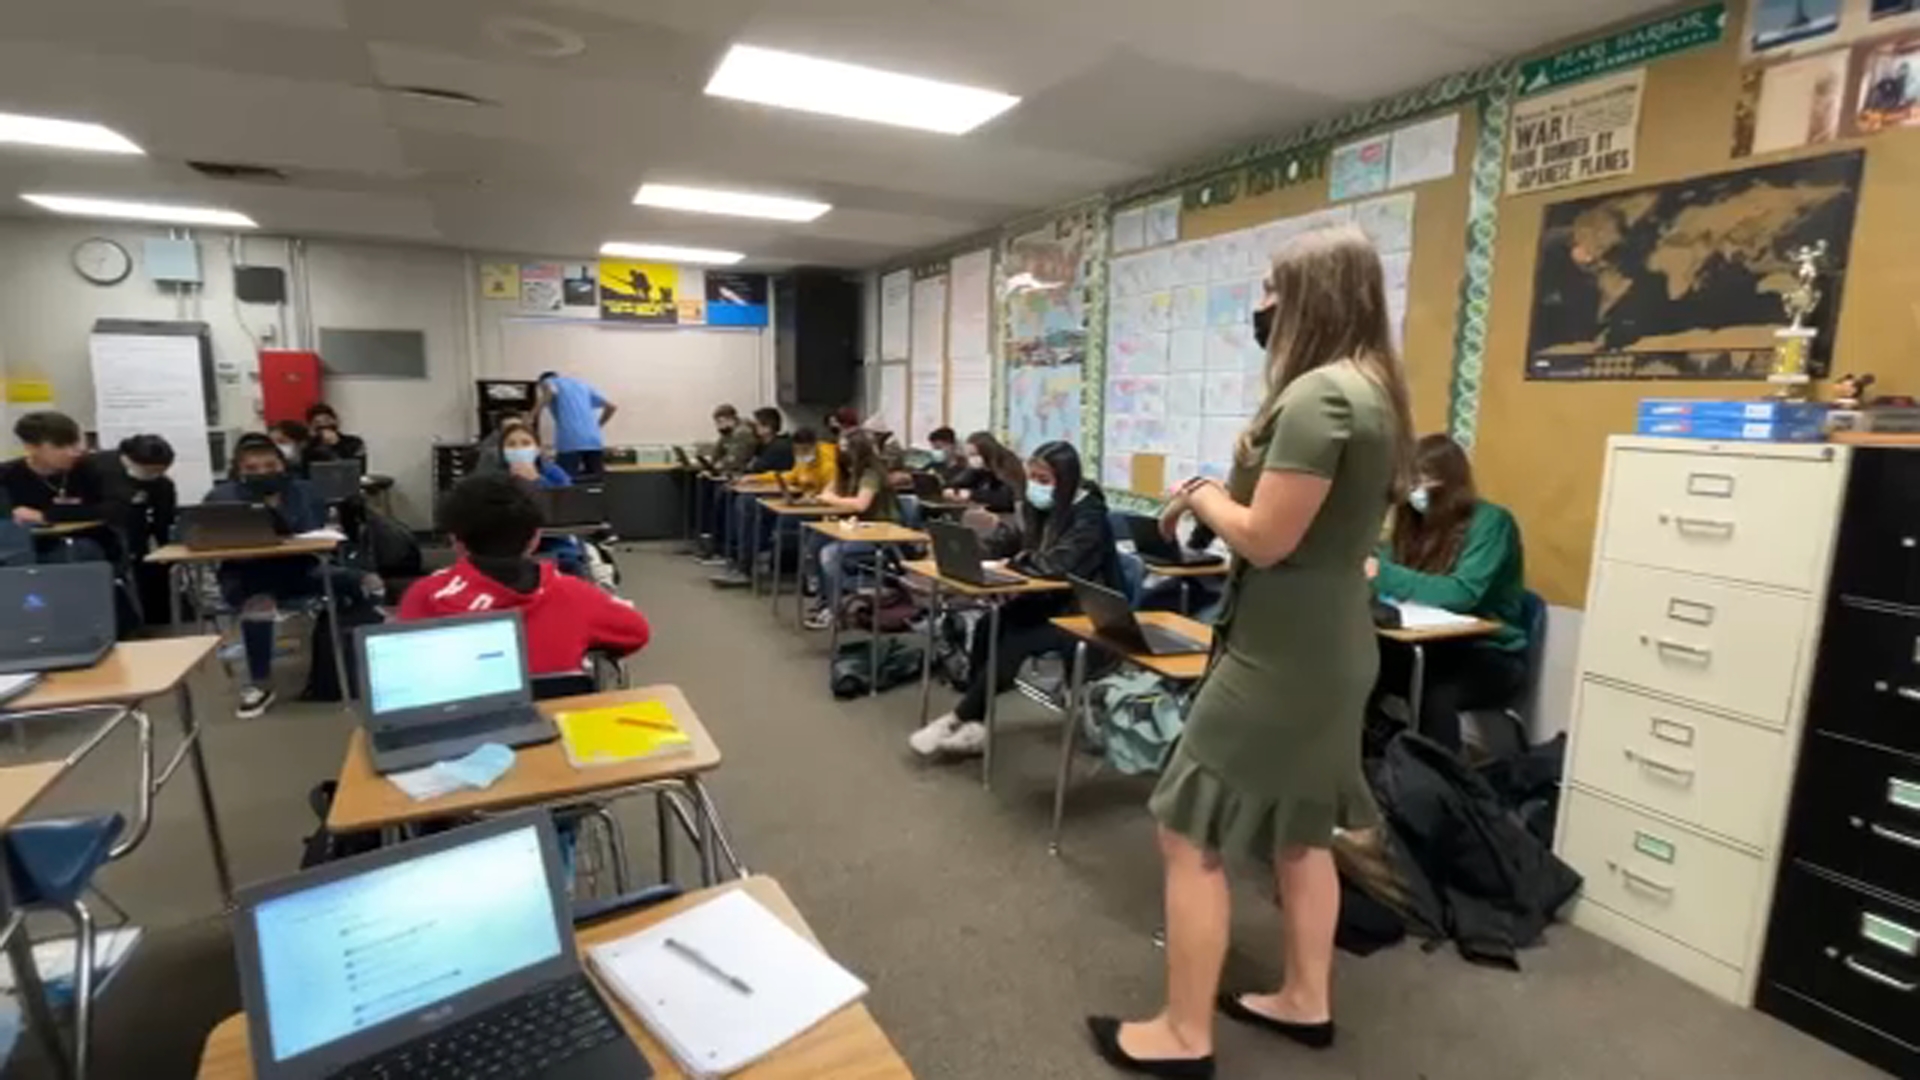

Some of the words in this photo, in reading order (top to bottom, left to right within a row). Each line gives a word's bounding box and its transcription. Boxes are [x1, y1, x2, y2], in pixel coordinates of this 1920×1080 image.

[1554, 42, 1607, 68] PEARL
[1616, 13, 1708, 51] HARBOR
[1516, 160, 1573, 189] JAPANESE
[1580, 148, 1630, 177] PLANES
